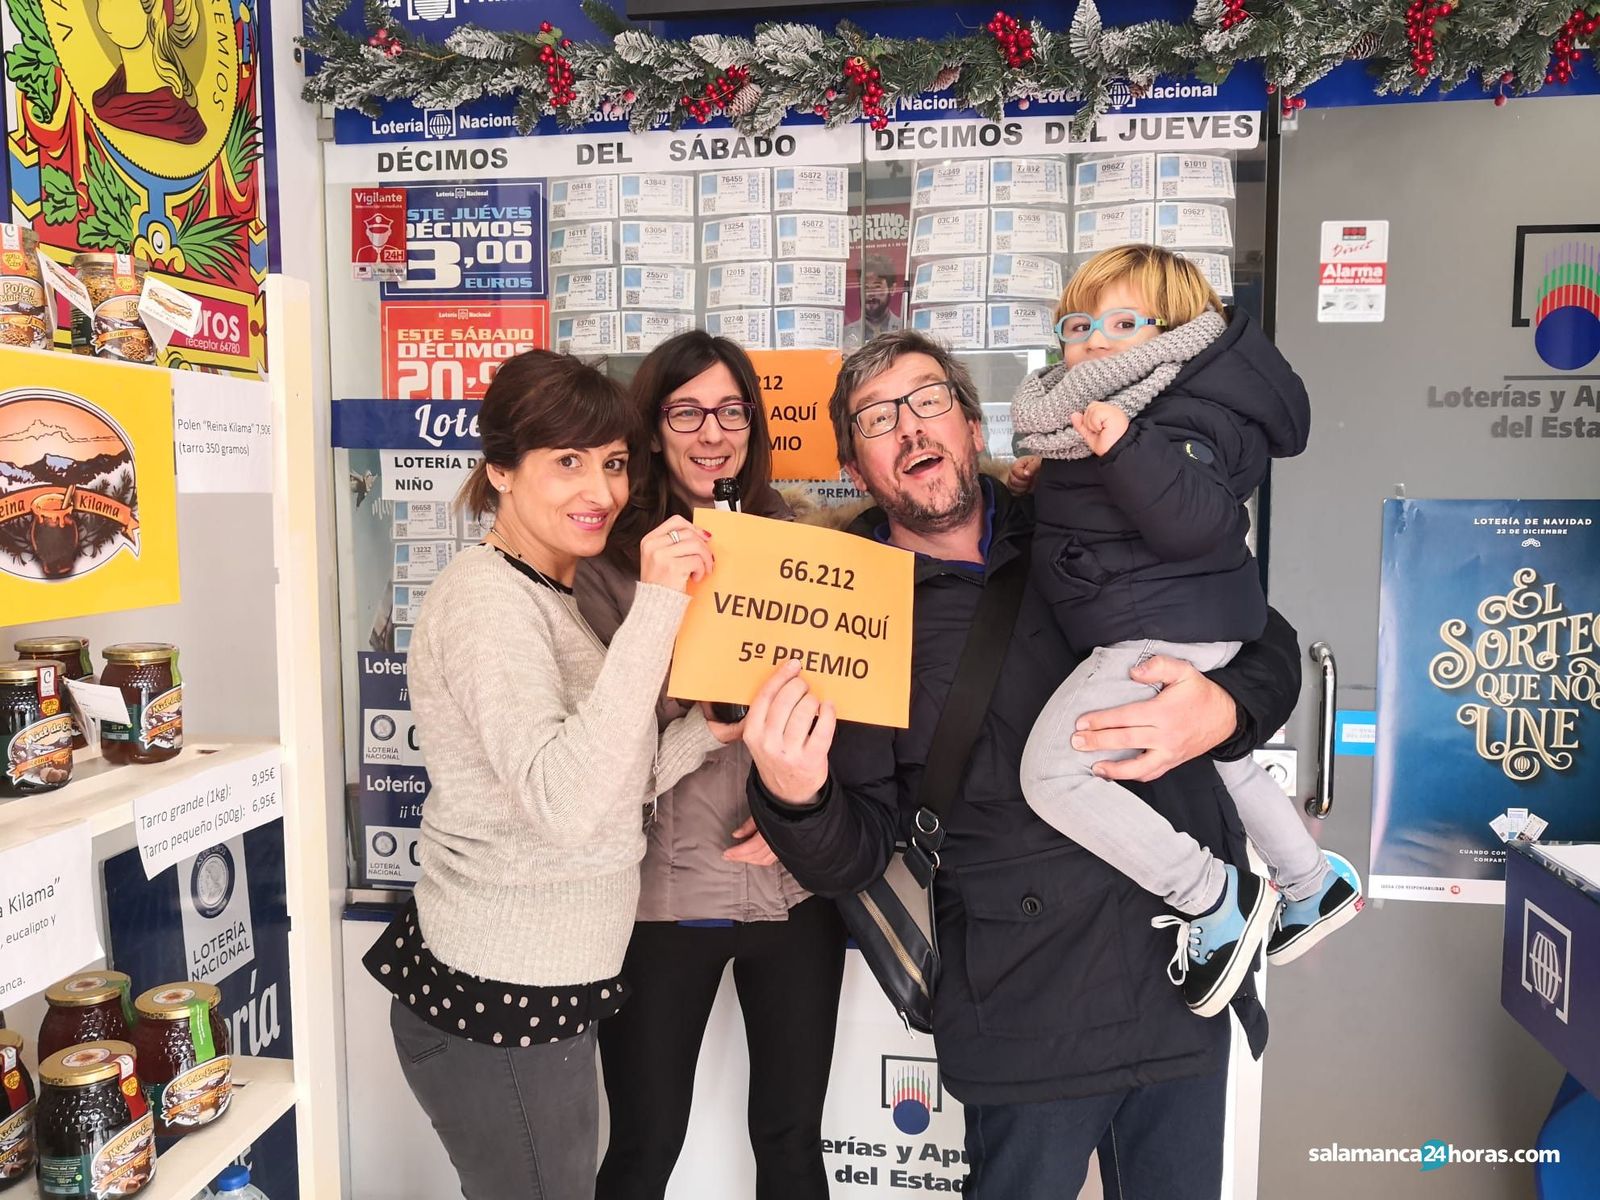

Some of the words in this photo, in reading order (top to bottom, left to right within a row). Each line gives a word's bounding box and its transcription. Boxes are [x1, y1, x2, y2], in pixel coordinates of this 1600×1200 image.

[211, 0, 229, 111] EMIOS
[371, 119, 424, 135] Lotería
[459, 113, 519, 132] Naciona
[875, 123, 1022, 151] DÉCIMOS
[1119, 113, 1253, 146] JUEVES
[377, 145, 508, 172] DÉCIMOS
[576, 143, 633, 166] DEL
[669, 133, 797, 162] SÁBADO
[355, 191, 403, 206] Vigilante
[407, 206, 445, 220] STE
[384, 250, 404, 261] 24H
[1322, 263, 1384, 279] Alarma
[4, 282, 35, 298] Polen
[465, 276, 533, 289] EUROS
[198, 307, 241, 344] ros
[397, 328, 445, 341] ESTE
[450, 325, 535, 341] SÁBADO
[185, 337, 217, 353] receptor
[219, 340, 241, 355] 64780
[1427, 383, 1541, 409] Loterías
[1550, 390, 1567, 413] y
[770, 401, 819, 424] AQUÍ
[177, 418, 202, 432] Polen
[1490, 414, 1533, 440] del
[1540, 416, 1600, 440] Esta
[178, 441, 204, 455] (tarro
[205, 442, 220, 455] 350
[221, 444, 250, 457] gramos)
[394, 454, 463, 469] LOTERÍA
[394, 476, 434, 491] NIÑO
[0, 498, 26, 520] eina
[79, 495, 121, 520] Kilama
[1473, 516, 1520, 526] LOTERÍA
[1524, 517, 1538, 526] DE
[1542, 517, 1593, 527] NAVIDAD
[779, 557, 856, 591] 66.212
[713, 590, 830, 629] VENDIDO
[834, 611, 890, 641] AQUÍ
[738, 641, 766, 663] 5º
[772, 645, 869, 680] PREMIO
[1428, 612, 1600, 690] SORTE
[364, 657, 408, 675] Loter
[1475, 672, 1541, 707] QUE
[365, 753, 400, 761] NACIONAL
[367, 746, 399, 754] LOTERÍA
[366, 775, 426, 794] Lotería
[141, 811, 168, 831] Tarro
[169, 797, 205, 822] grande
[205, 784, 233, 812] (1kg):
[251, 766, 277, 789] 9,95€
[144, 841, 169, 863] Tarro
[170, 820, 213, 851] pequeño
[214, 807, 247, 837] (500g):
[251, 791, 277, 815] 6,95€
[1459, 848, 1489, 856] CUANDO
[1491, 849, 1507, 857] COM
[1473, 856, 1507, 864] COMPART
[367, 868, 402, 877] NACIONAL
[369, 861, 401, 870] LOTERÍA
[6, 917, 50, 944] eucalipto
[51, 913, 57, 927] y
[192, 920, 247, 966] LOTERÍA
[191, 937, 251, 982] NACIONAL
[0, 977, 26, 996] anca.
[821, 1136, 888, 1158] erías
[896, 1145, 913, 1165] y
[834, 1164, 878, 1186] del
[890, 1168, 968, 1193] Estad
